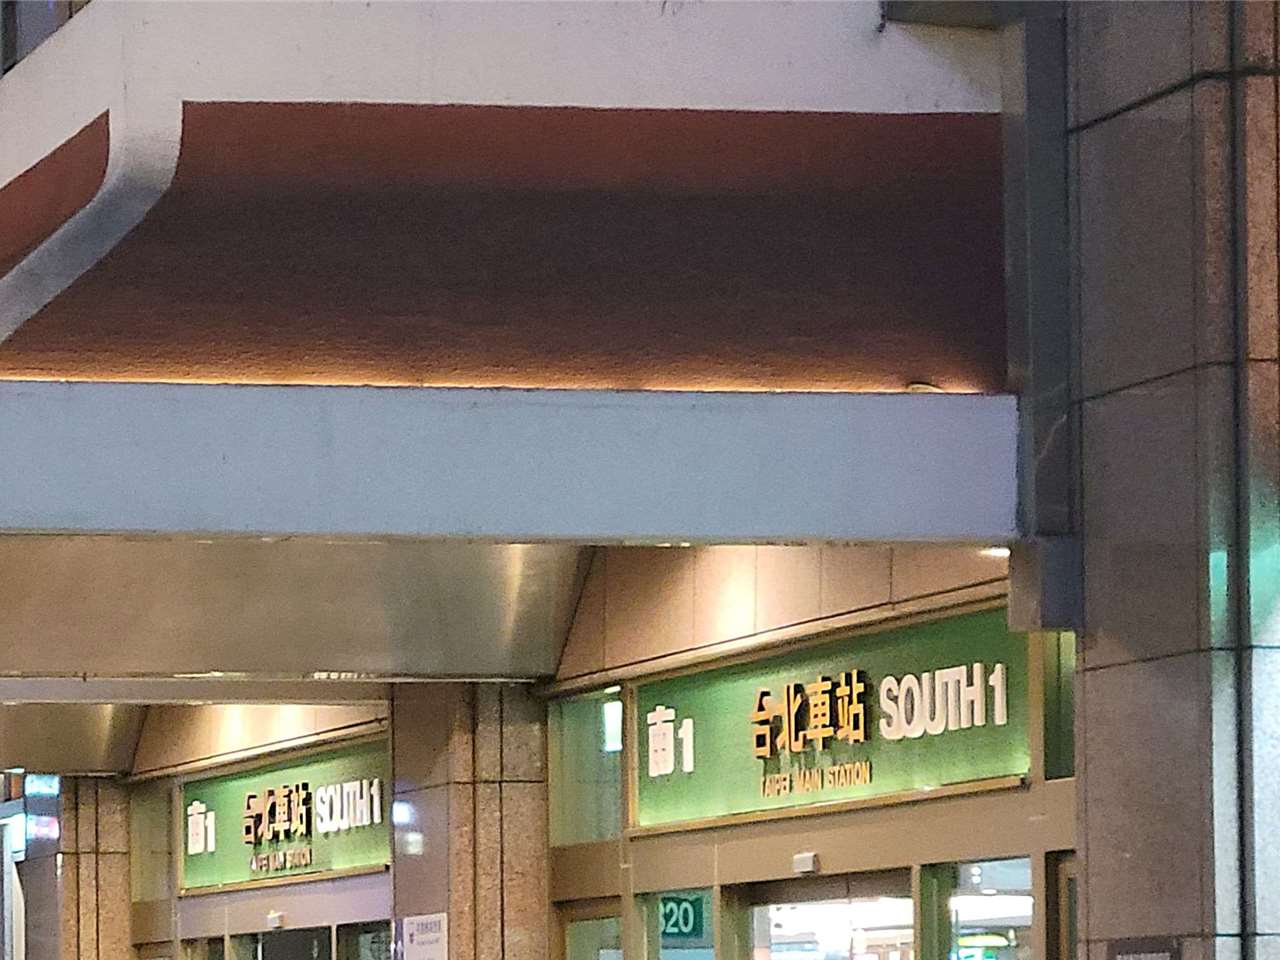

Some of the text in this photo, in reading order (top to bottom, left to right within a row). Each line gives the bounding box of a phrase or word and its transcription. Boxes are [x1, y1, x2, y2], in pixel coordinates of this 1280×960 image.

[751, 662, 1008, 757] 台北車站 SOUTH 1
[827, 760, 871, 787] STATION
[242, 781, 312, 844] 台北車站
[315, 779, 370, 833] SOUTH
